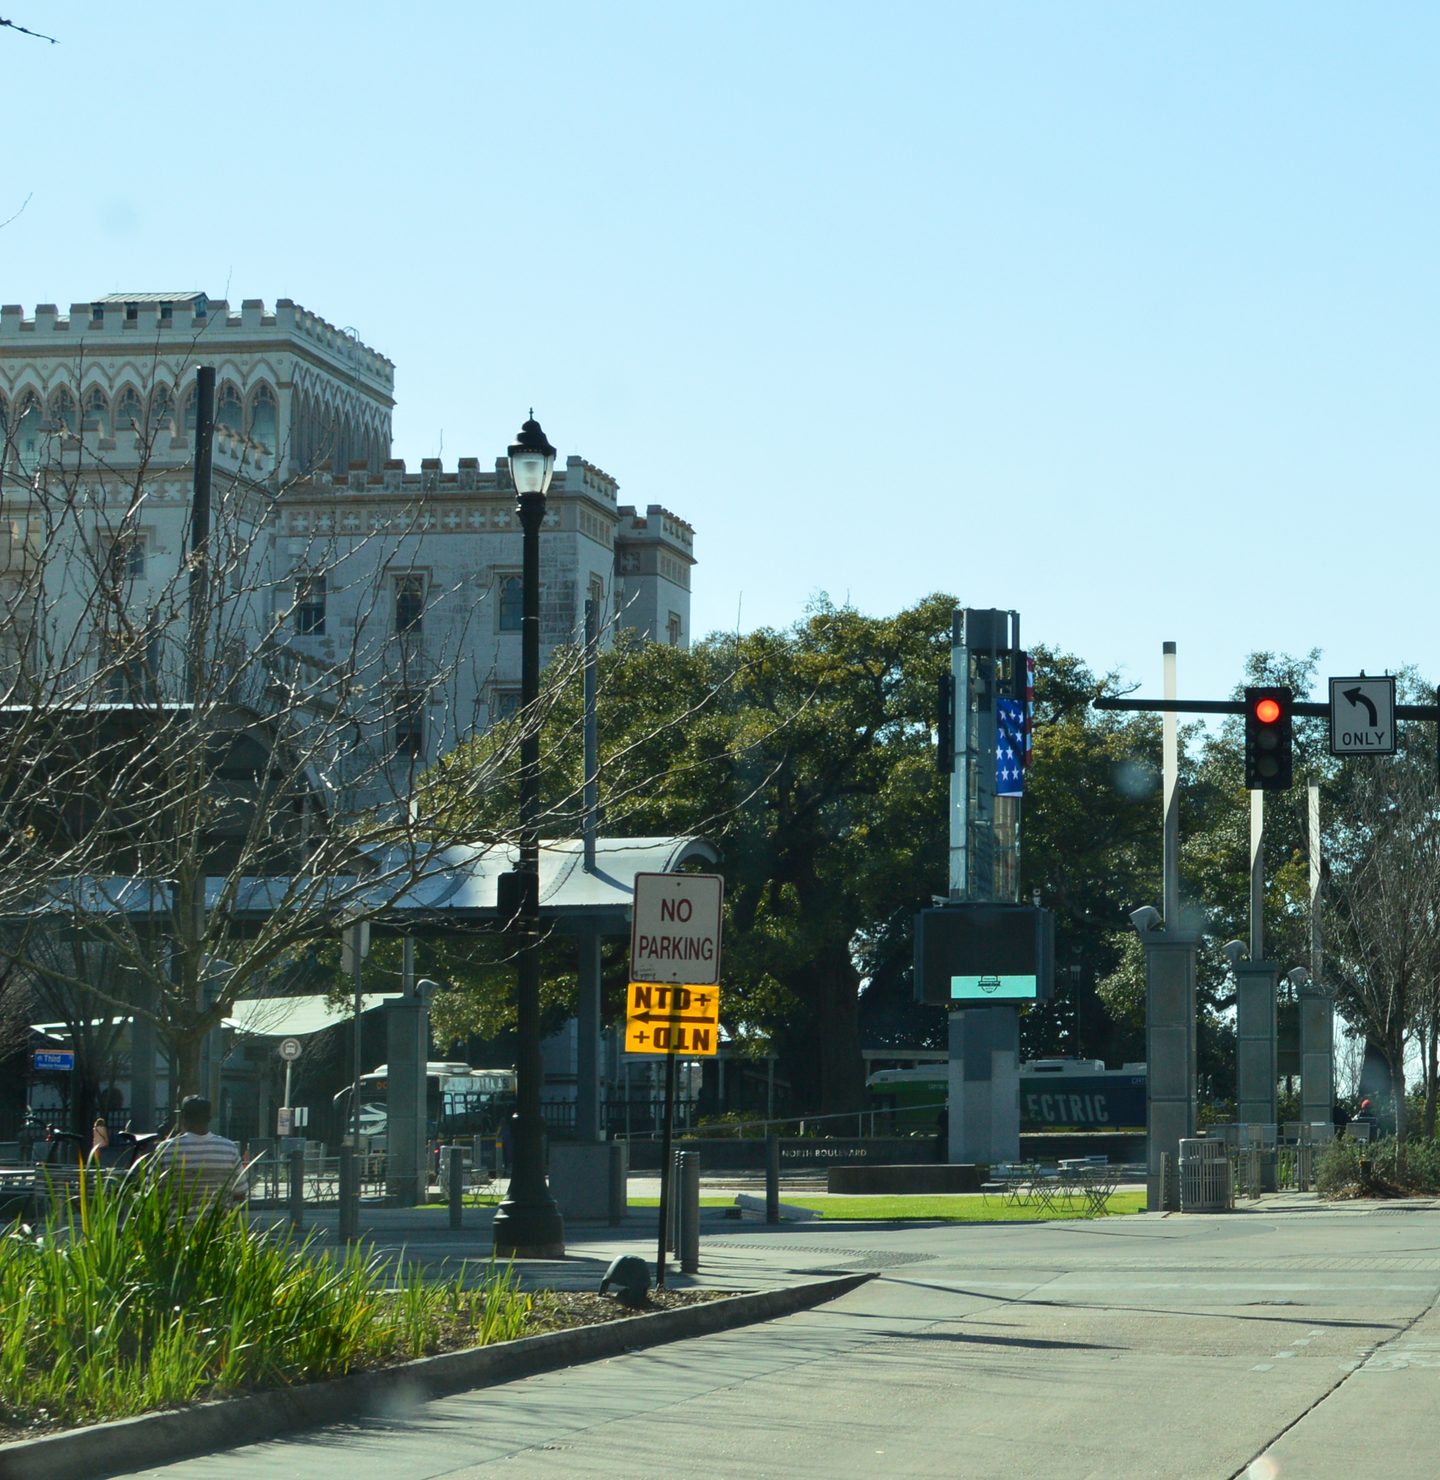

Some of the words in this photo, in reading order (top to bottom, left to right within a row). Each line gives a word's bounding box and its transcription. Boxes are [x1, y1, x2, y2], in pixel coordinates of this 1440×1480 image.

[1342, 731, 1385, 746] ONLY
[661, 898, 692, 922] NO
[639, 935, 713, 960] PARKING
[782, 1149, 813, 1157] NORTH
[815, 1149, 867, 1157] BOULARD
